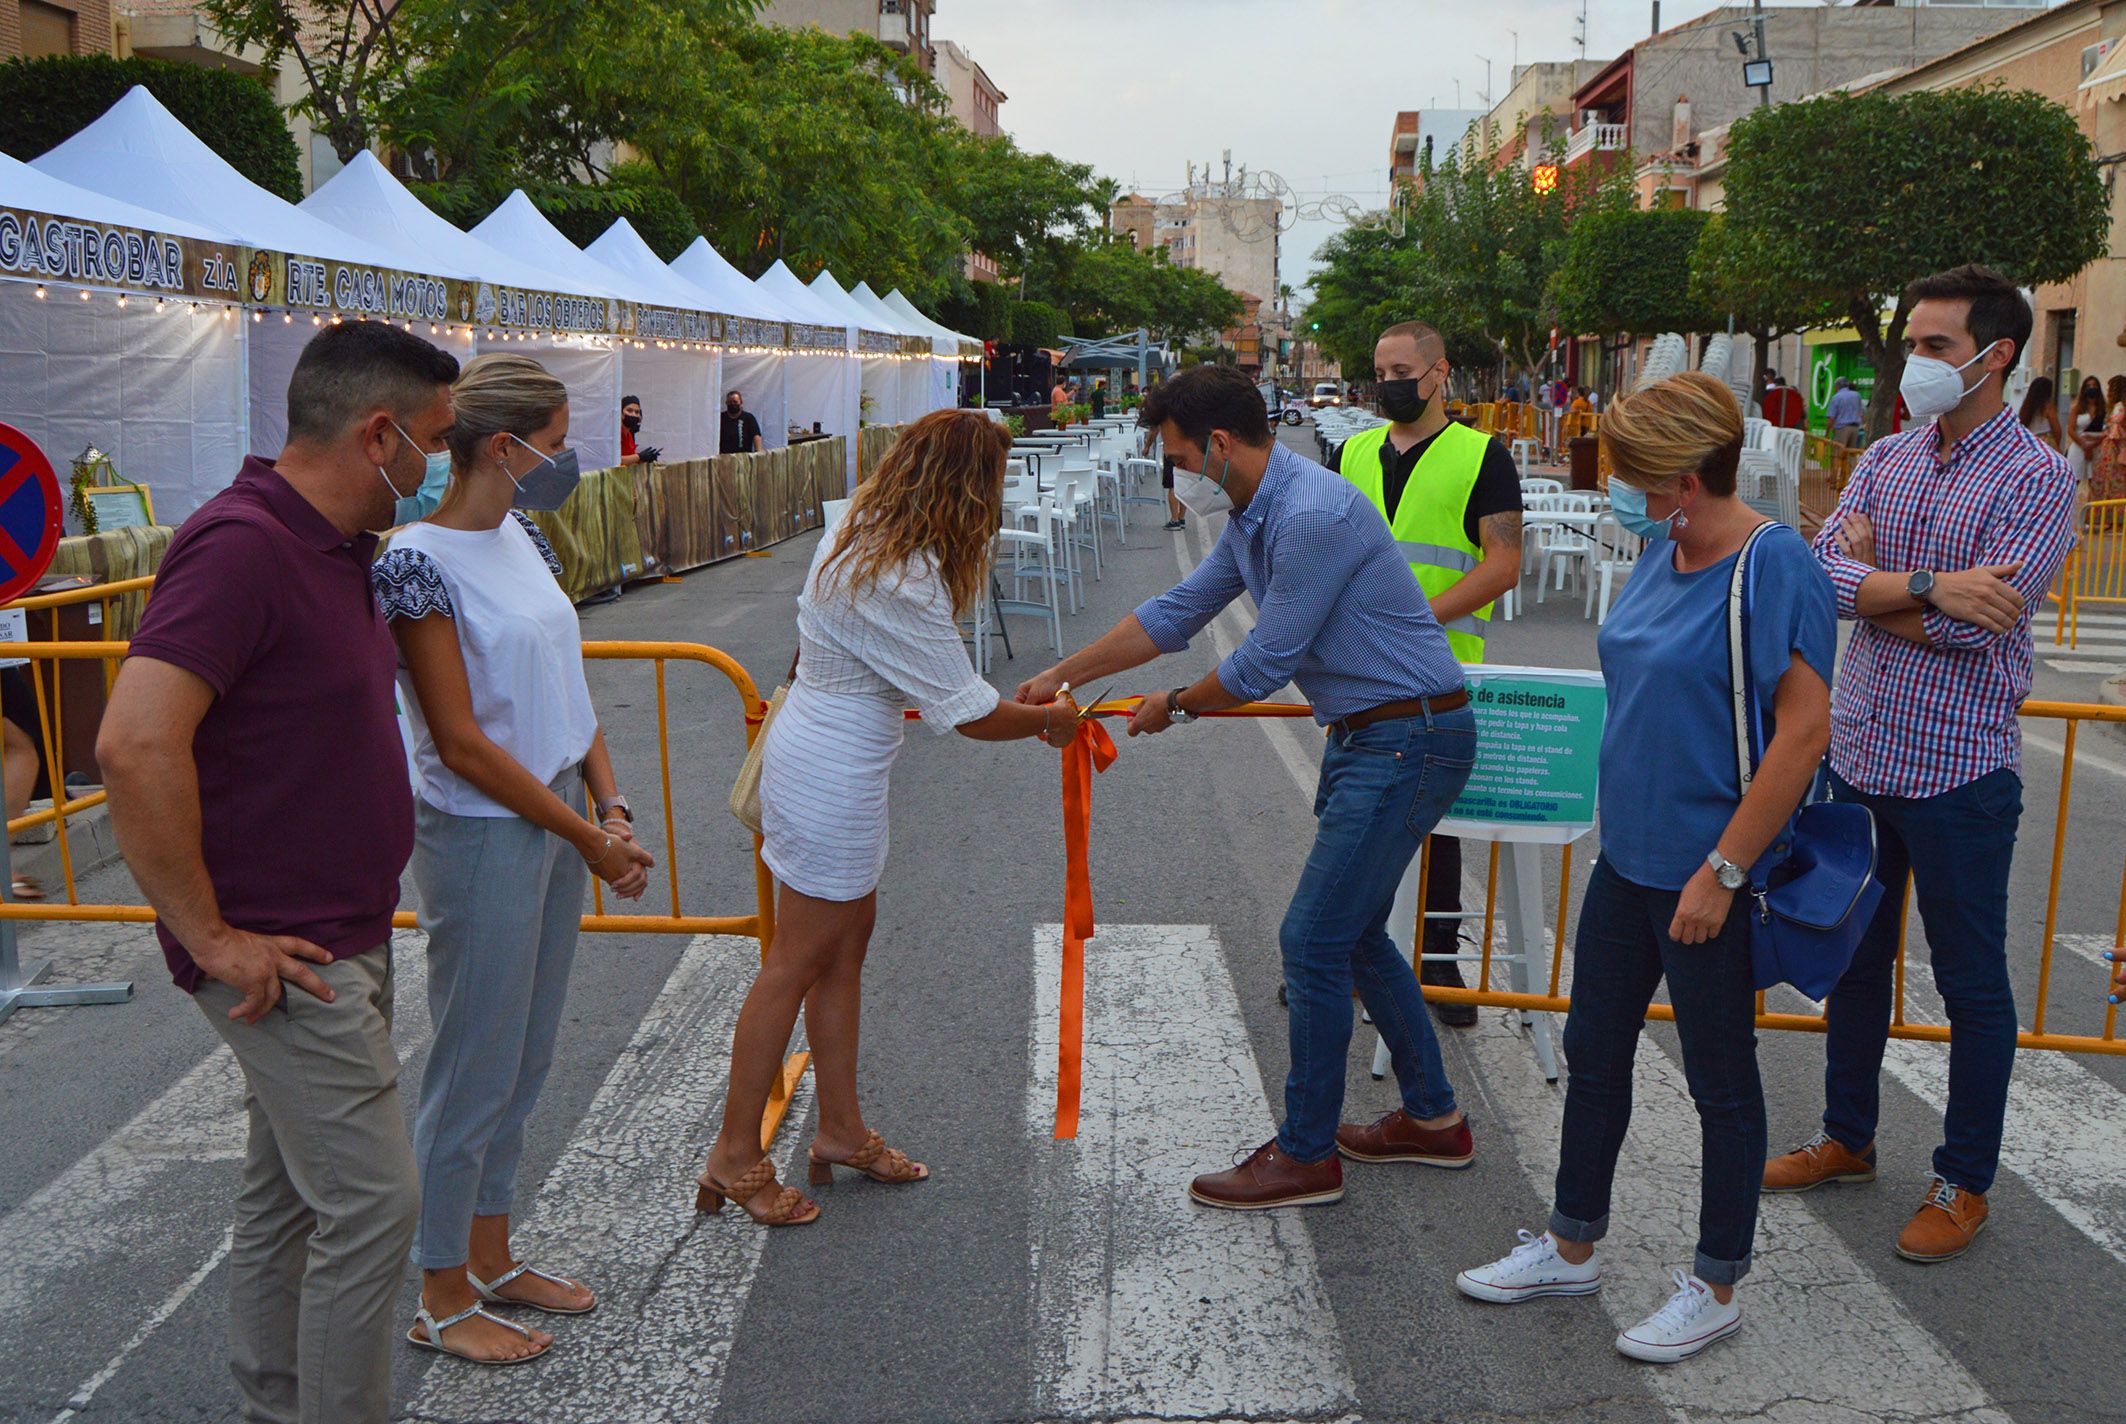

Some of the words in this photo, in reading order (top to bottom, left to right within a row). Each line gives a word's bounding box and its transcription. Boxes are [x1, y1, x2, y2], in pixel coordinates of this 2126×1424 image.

[0, 212, 184, 290] GASTROBAR
[287, 258, 331, 308] RTE.
[334, 265, 387, 313] CASA
[389, 273, 448, 320] MOTOS
[499, 289, 527, 326] BAR
[528, 293, 553, 329] LOS
[553, 296, 604, 332] OBREROS
[1477, 688, 1494, 703] de
[1497, 691, 1566, 709] asistencia
[1489, 707, 1508, 716] todos
[1508, 709, 1519, 717] los
[1520, 711, 1533, 720] que
[1475, 718, 1487, 726] nde
[1488, 719, 1505, 728] pedir
[1506, 720, 1513, 728] la
[1514, 721, 1529, 731] tapa
[1530, 724, 1535, 732] y
[1535, 723, 1552, 733] haga
[1553, 725, 1568, 733] cola
[1481, 729, 1489, 738] de
[1490, 730, 1522, 740] distancia.
[1476, 740, 1502, 750] ompaña
[1503, 742, 1510, 750] la
[1511, 743, 1526, 753] tapa
[1544, 745, 1564, 754] stand
[1564, 747, 1573, 755] de
[1483, 752, 1506, 761] metros
[1507, 754, 1516, 762] de
[1517, 755, 1549, 764] distancia.
[1516, 766, 1551, 776] papeleras.
[1504, 776, 1514, 784] los
[1515, 777, 1539, 786] stands.
[1464, 784, 1487, 792] cuanto
[1497, 786, 1523, 796] termine
[1535, 790, 1584, 800] consumiciones.
[1454, 807, 1464, 815] no
[1465, 808, 1475, 816] se
[1498, 800, 1508, 808] es
[1509, 800, 1559, 812] OBLIGATORIO
